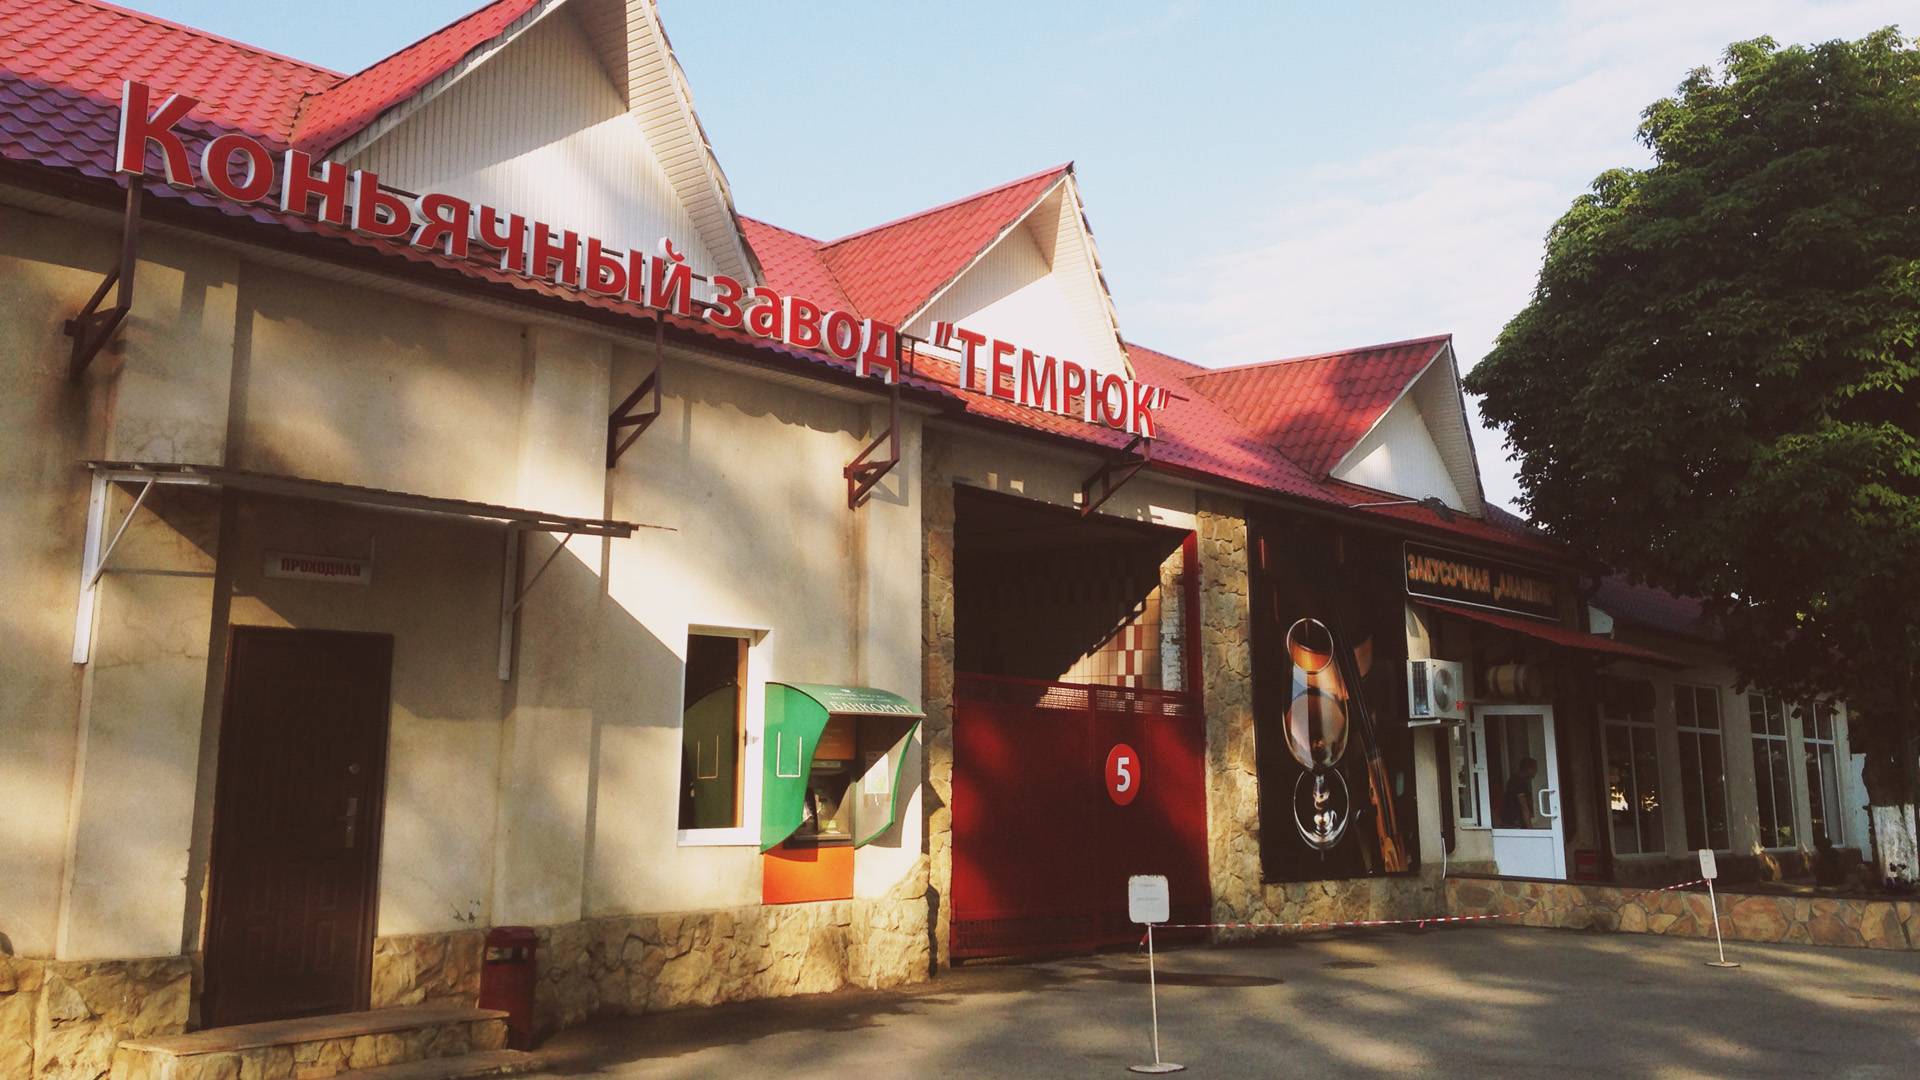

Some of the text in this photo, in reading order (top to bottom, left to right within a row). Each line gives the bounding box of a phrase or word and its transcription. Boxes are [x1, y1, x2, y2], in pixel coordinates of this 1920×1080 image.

[116, 80, 692, 318] Коньячный
[703, 274, 900, 384] завод
[281, 558, 361, 577] ПРОХОДНАЯ
[1407, 554, 1490, 593] ЗАКУСОЧНАЯ
[830, 701, 913, 714] БАНКОМАТ
[1116, 757, 1131, 792] 5
